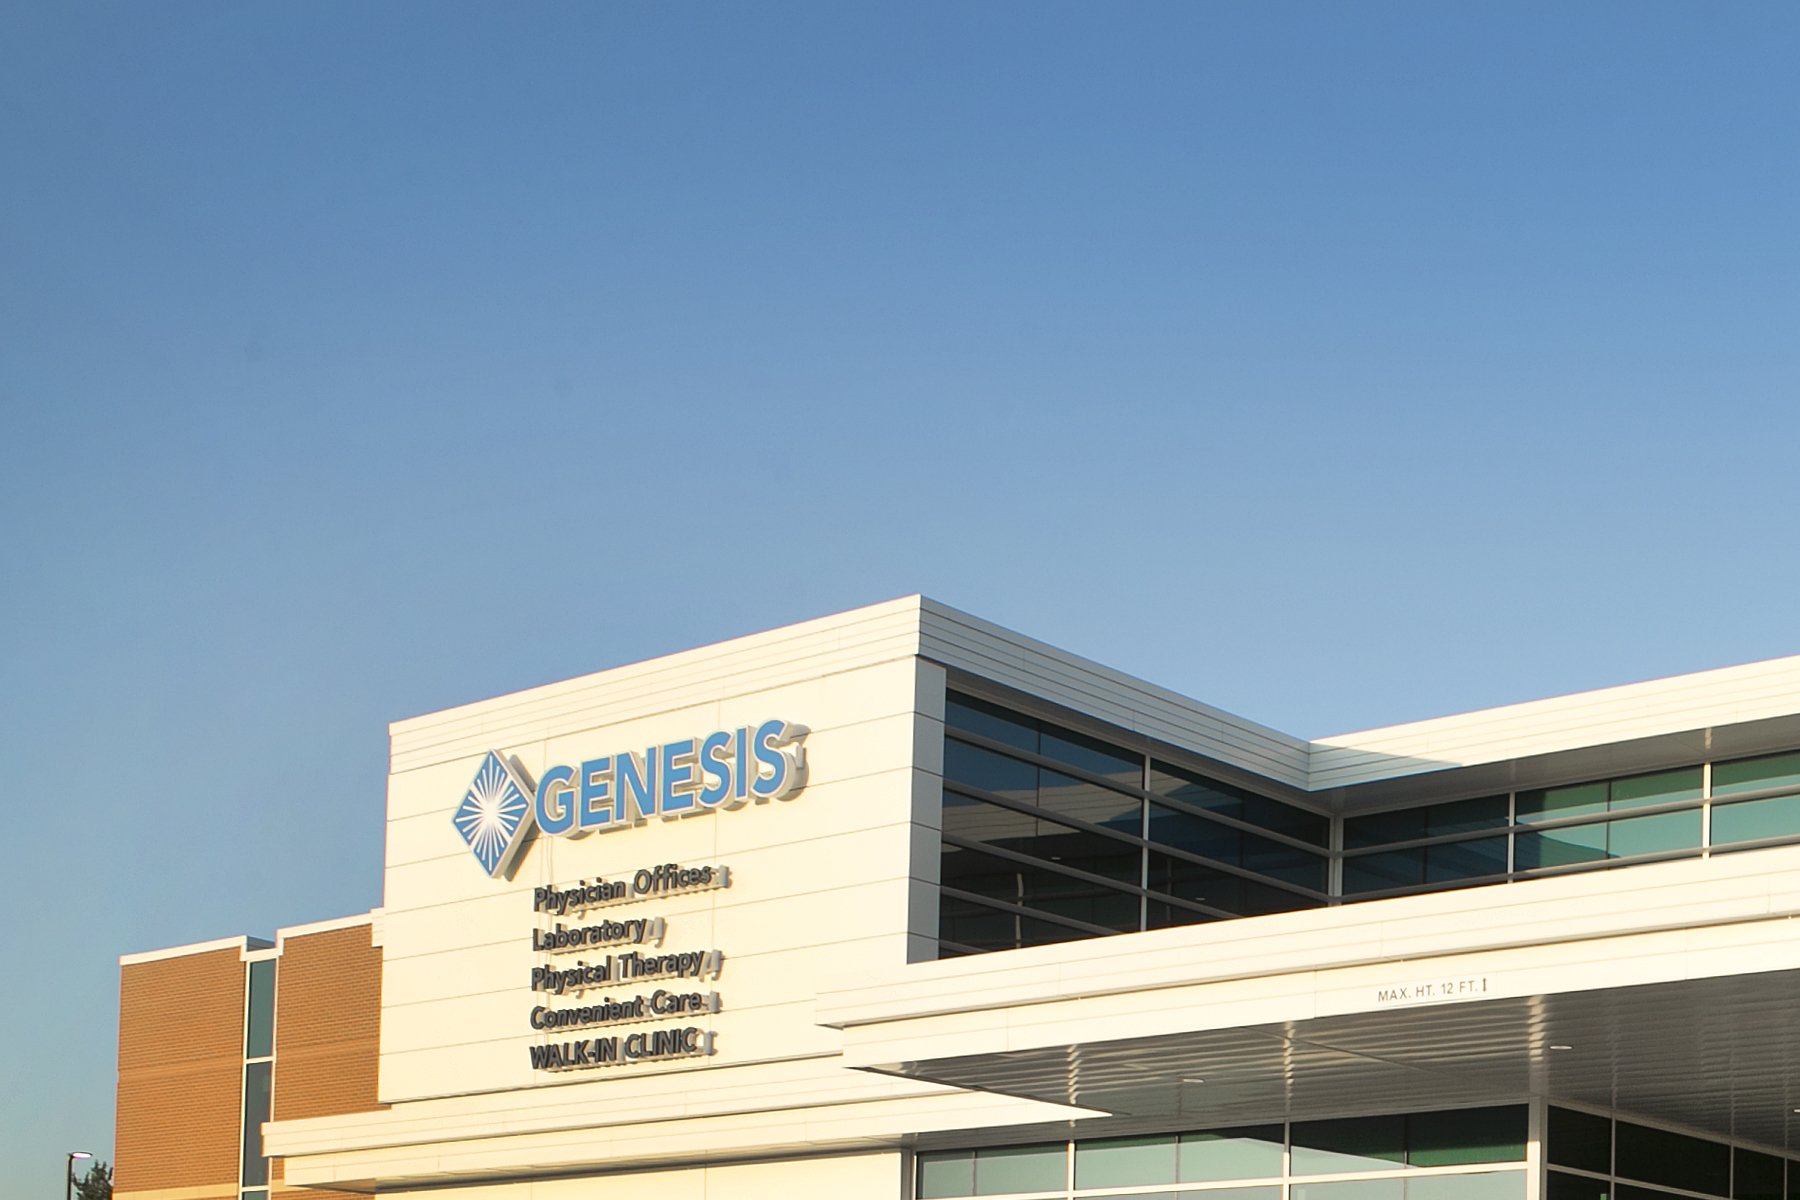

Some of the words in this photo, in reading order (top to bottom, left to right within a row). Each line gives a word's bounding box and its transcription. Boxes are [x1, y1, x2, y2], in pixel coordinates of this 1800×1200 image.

[535, 719, 790, 837] GENESIS
[533, 877, 626, 915] Physician
[633, 863, 712, 895] Offices
[532, 918, 648, 952] Laboratory
[531, 955, 612, 995] Physical
[618, 951, 705, 978] Therapy
[1378, 987, 1411, 1002] MAX.
[1416, 984, 1435, 997] HT.
[1441, 982, 1454, 994] 12
[1459, 980, 1478, 993] FT.
[530, 996, 644, 1030] Convenient
[651, 989, 701, 1015] Care
[529, 1037, 618, 1070] WALK-IN
[624, 1027, 698, 1059] CLINIC
